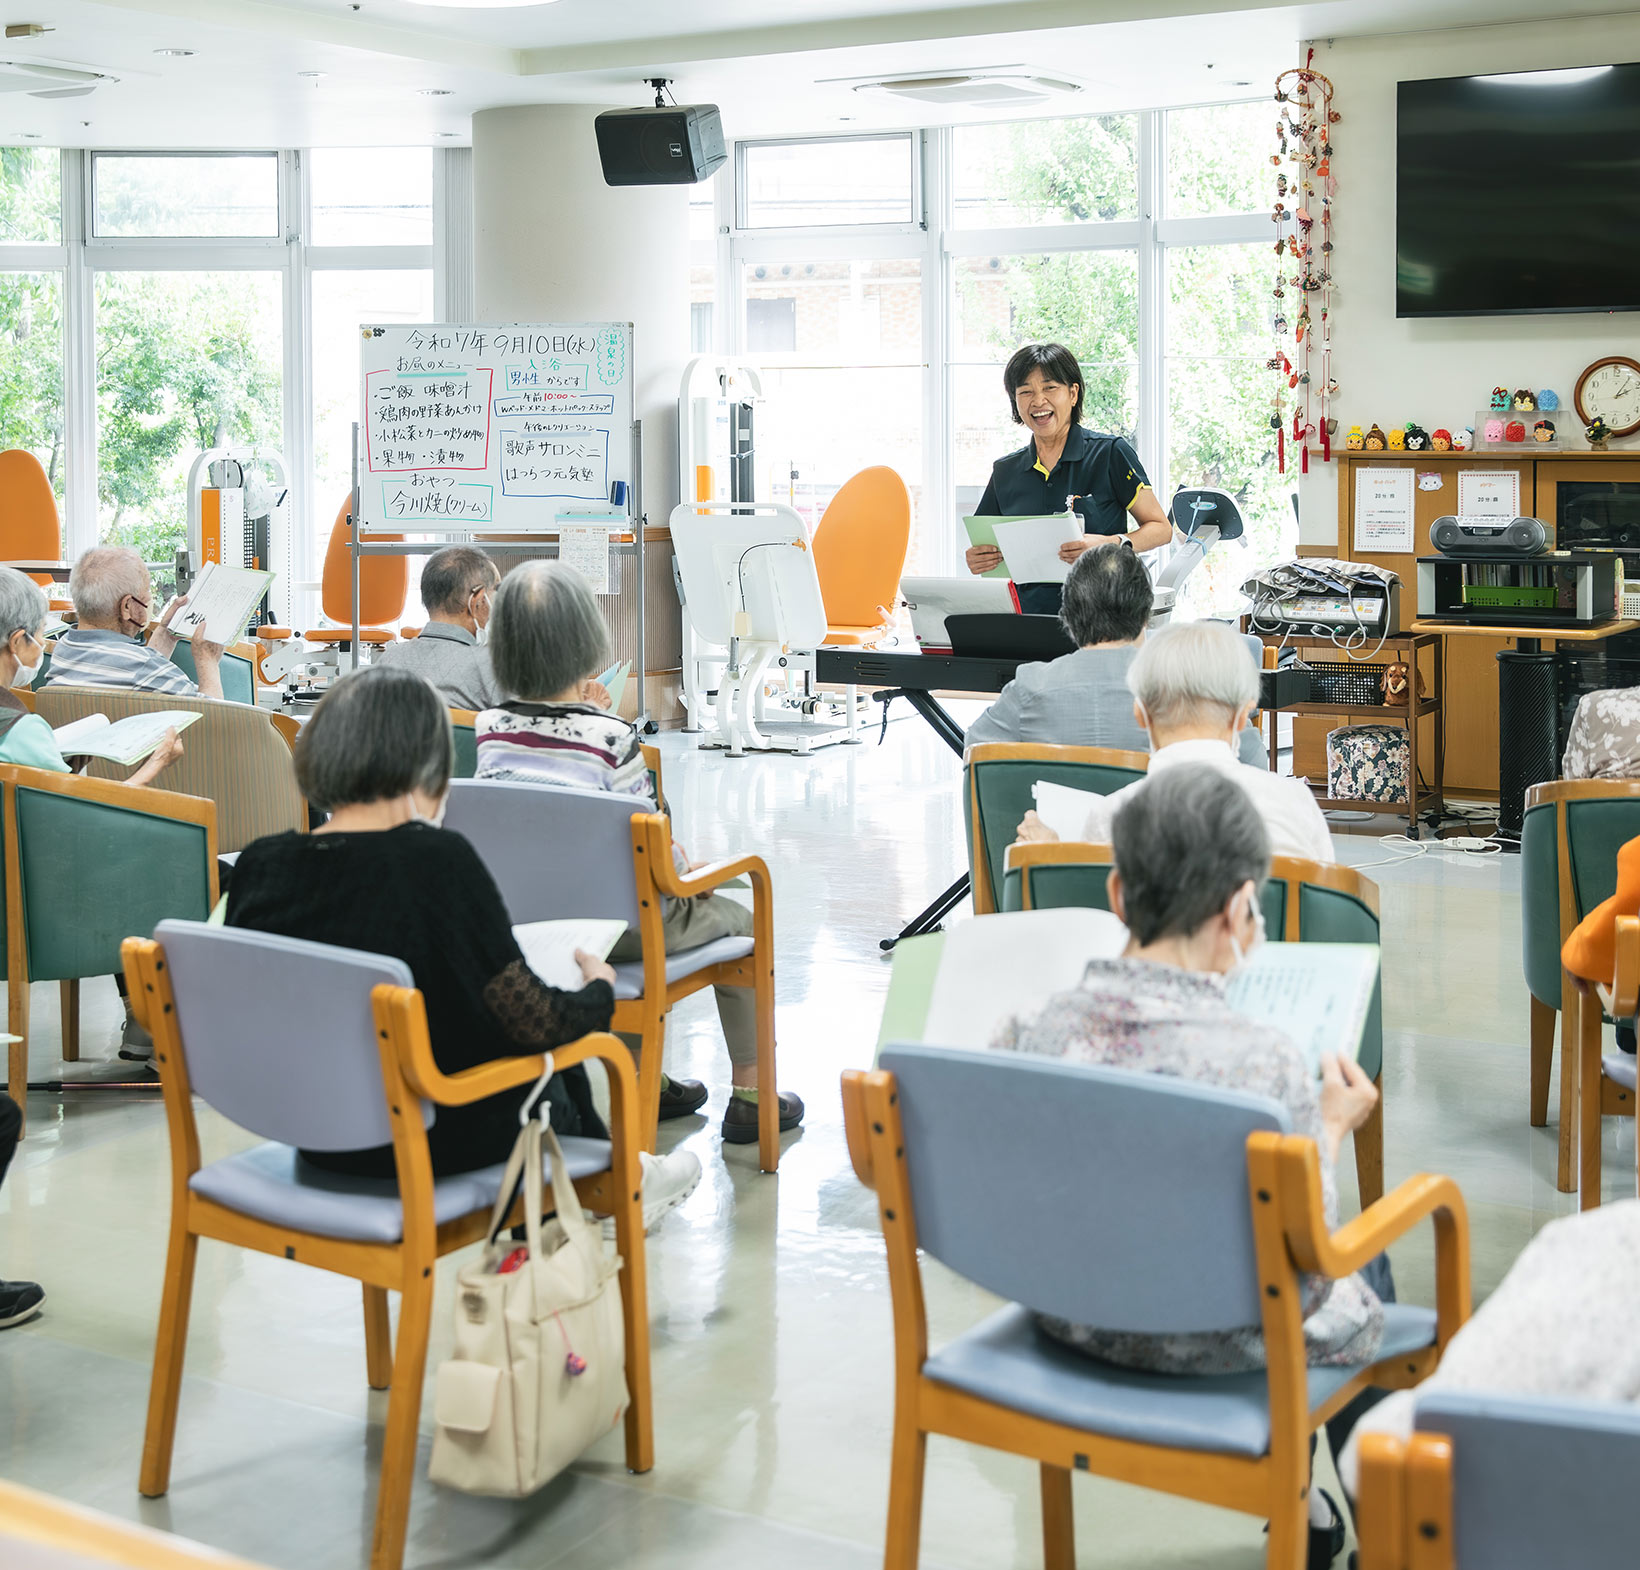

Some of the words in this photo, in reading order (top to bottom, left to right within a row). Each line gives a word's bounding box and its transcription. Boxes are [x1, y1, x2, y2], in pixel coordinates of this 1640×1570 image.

[604, 333, 618, 379] 温泉の日
[396, 355, 473, 373] お昼のメニュー
[528, 358, 563, 371] 入浴
[510, 371, 541, 385] 男性
[1602, 372, 1607, 380] 11
[424, 381, 472, 399] 味噌汁
[1592, 381, 1599, 389] 10
[523, 421, 596, 433] 午後のレクリエーション
[1612, 417, 1617, 425] 6
[505, 439, 602, 460] 歌声サロンミニ
[409, 472, 456, 488] おやつ
[390, 490, 489, 519] 今川焼(クリーム)
